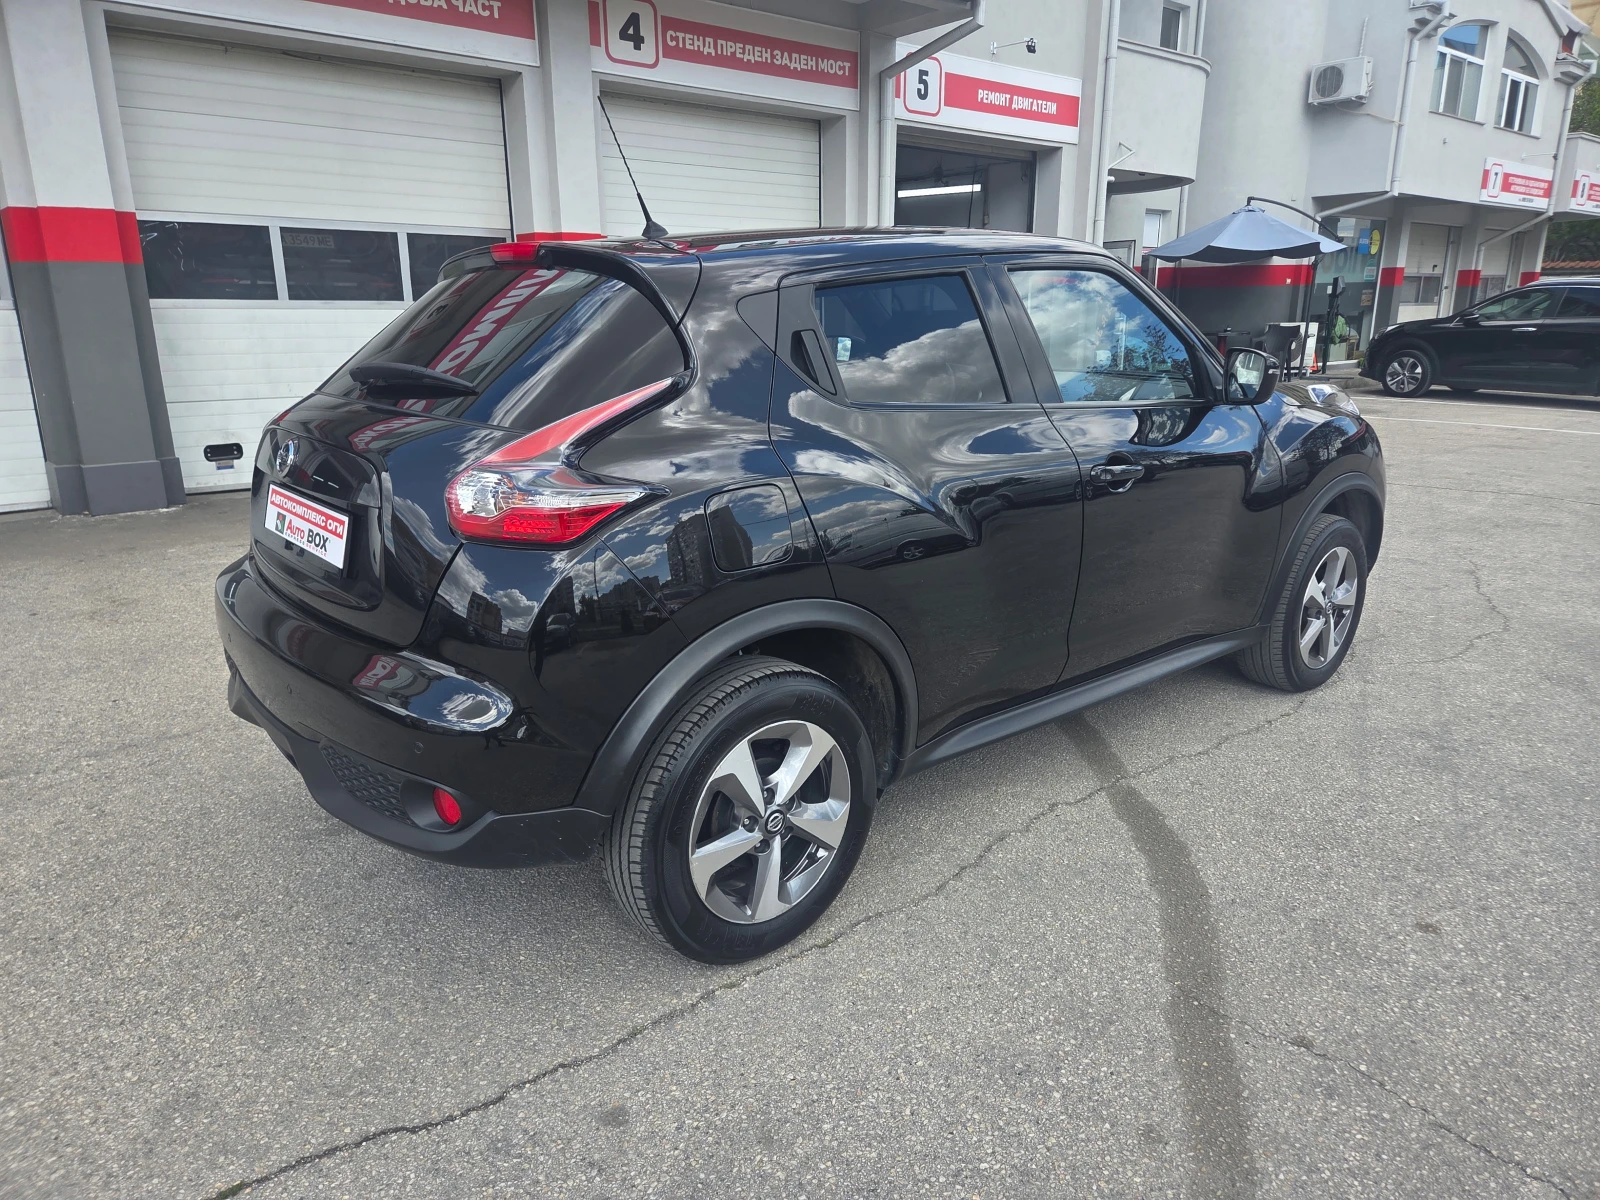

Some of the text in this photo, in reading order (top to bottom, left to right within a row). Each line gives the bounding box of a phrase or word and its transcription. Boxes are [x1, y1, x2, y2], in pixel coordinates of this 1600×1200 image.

[619, 12, 645, 51] 4
[666, 30, 851, 76] СТЕНД ПРЕДЕН ЗАДЕН МОСТ
[916, 68, 929, 101] 5
[978, 88, 1057, 115] РЕМОНТ ДВИГАТЕЛИ
[1492, 172, 1498, 190] 7
[289, 234, 316, 245] 3549
[271, 493, 344, 535] АВТОКОМПЛЕКС ОГИ
[307, 528, 329, 552] BOX
